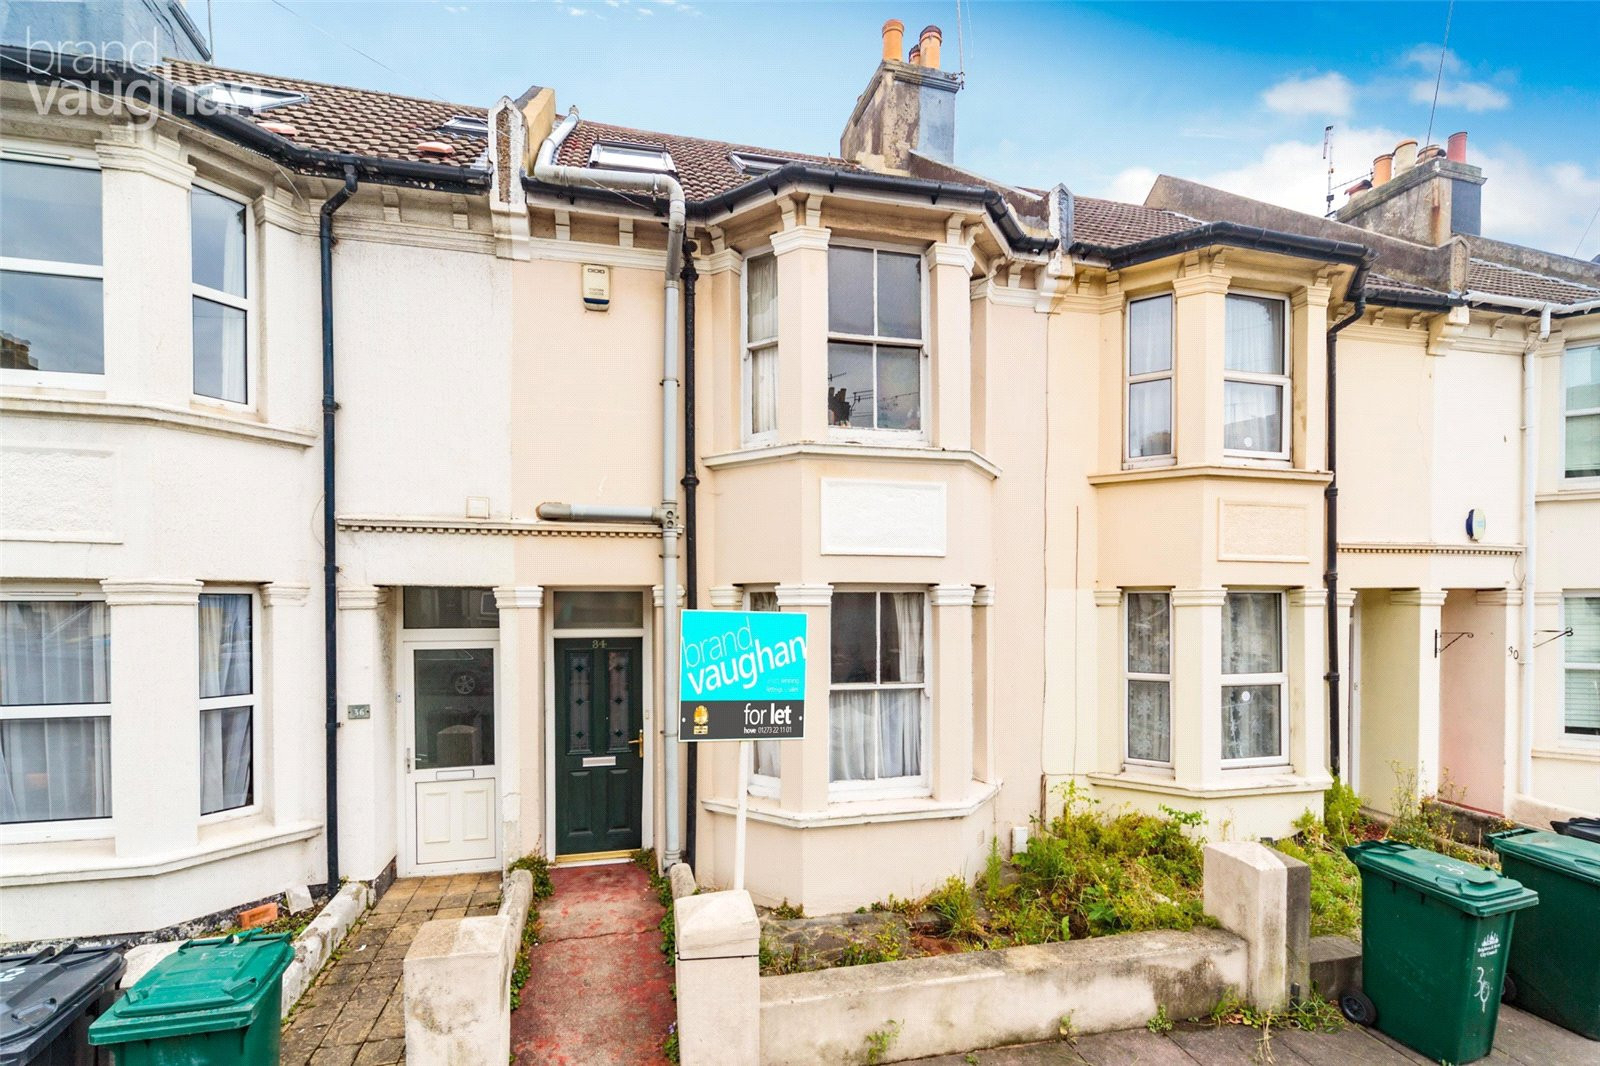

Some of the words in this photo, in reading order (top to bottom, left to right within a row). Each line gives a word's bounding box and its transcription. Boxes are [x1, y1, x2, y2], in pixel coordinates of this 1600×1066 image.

[682, 616, 753, 668] brand
[687, 636, 807, 695] vaughan
[743, 702, 767, 725] for
[770, 702, 792, 725] let
[743, 726, 757, 734] hove
[757, 726, 773, 734] 01273
